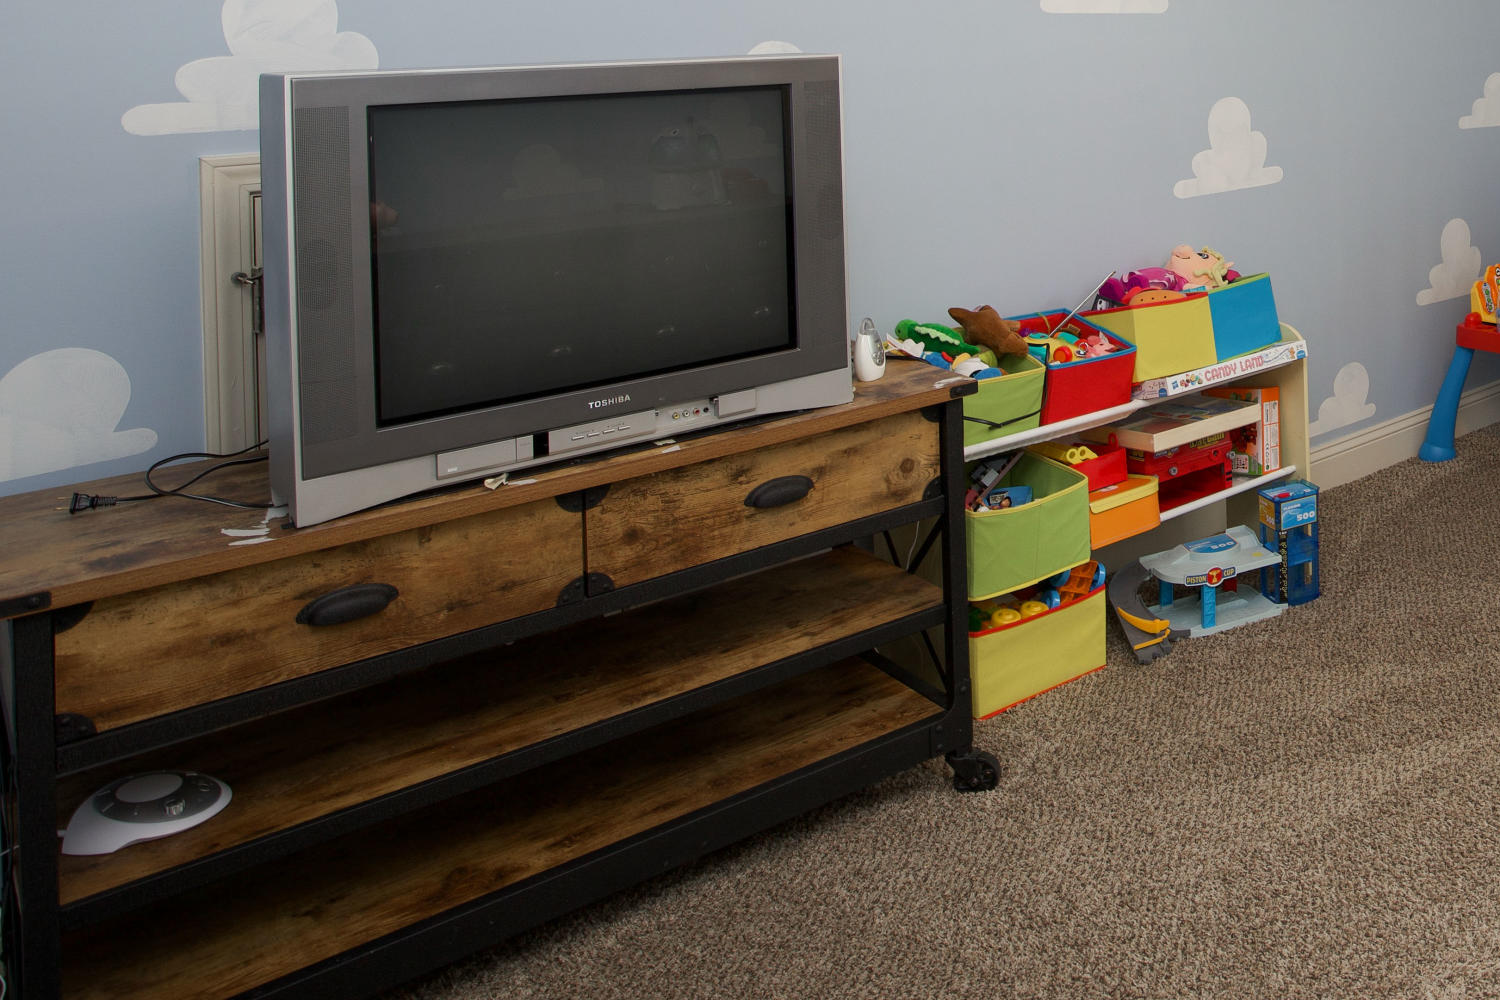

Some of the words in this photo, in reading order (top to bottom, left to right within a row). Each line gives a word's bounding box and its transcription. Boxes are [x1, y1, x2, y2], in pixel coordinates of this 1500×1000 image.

[1204, 361, 1237, 382] CANDY
[1240, 355, 1264, 372] LAND
[588, 394, 631, 409] TOSHIBA
[1296, 511, 1316, 522] 500
[1186, 574, 1208, 585] PISTON
[1223, 567, 1236, 577] CUP
